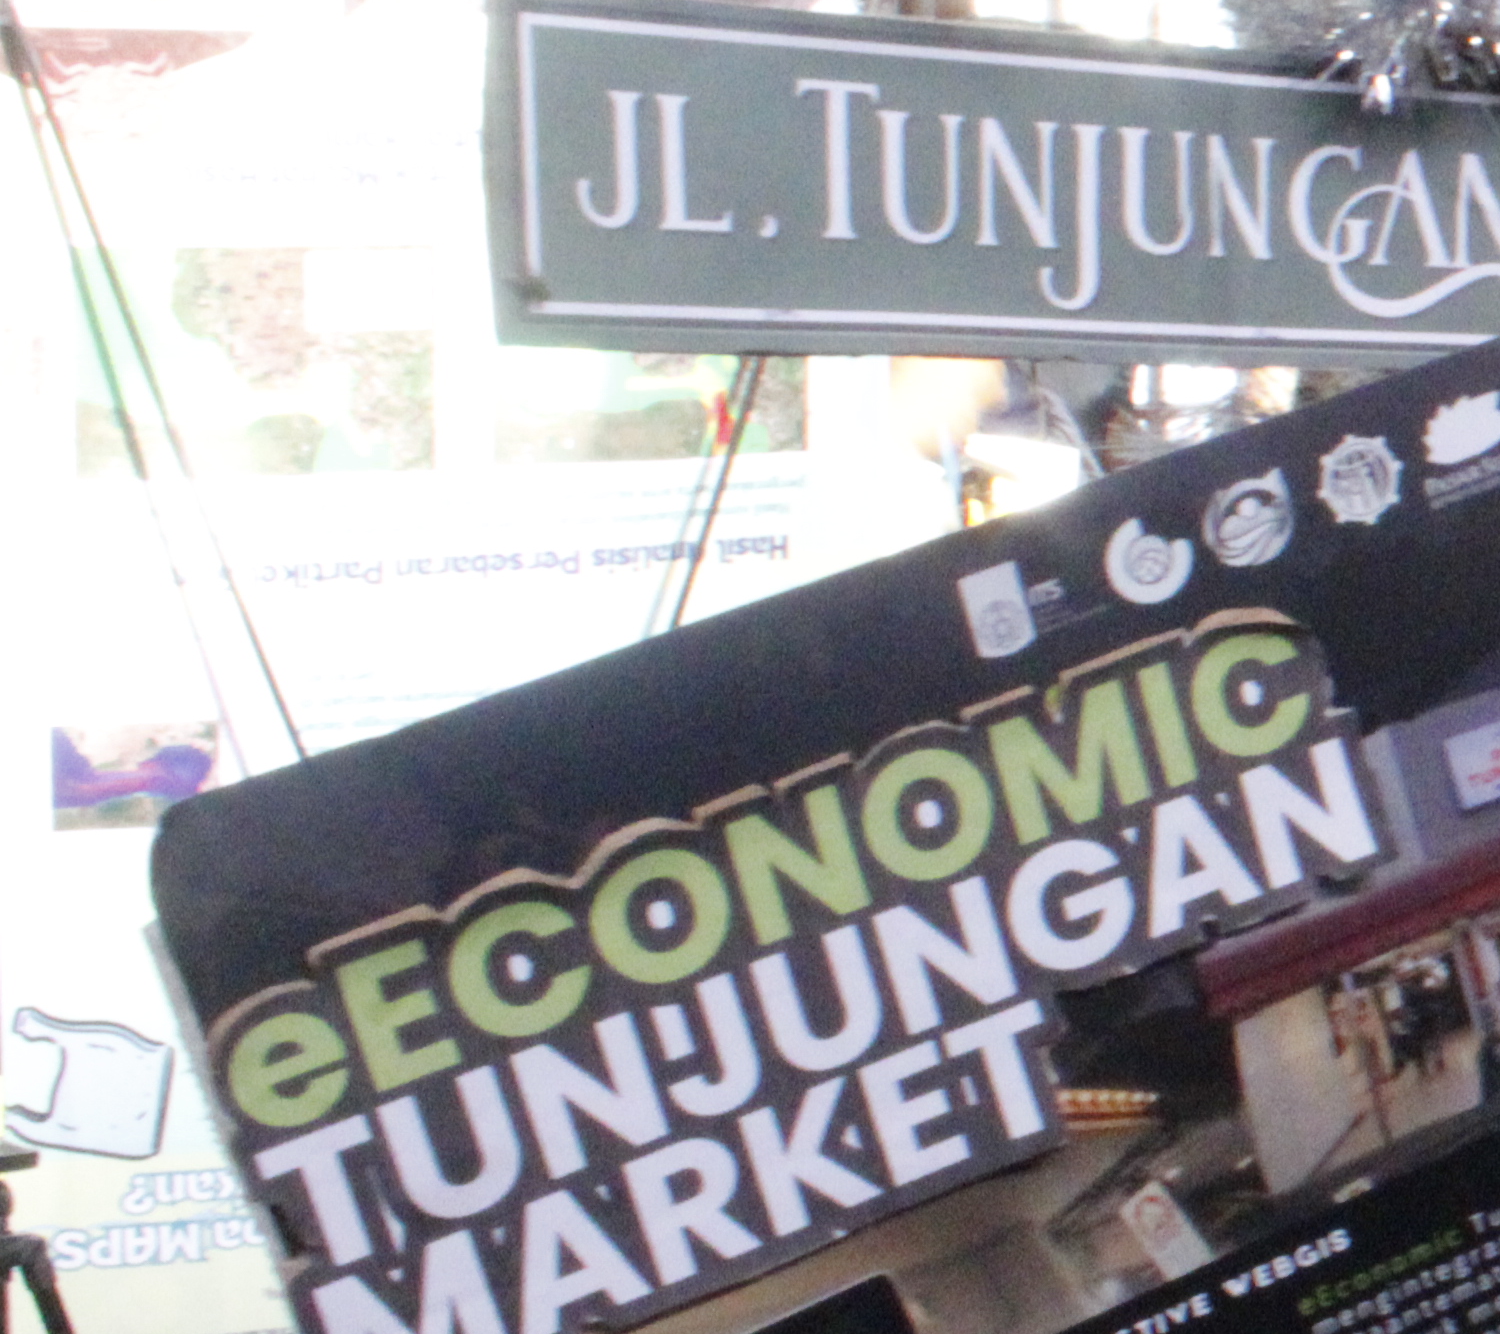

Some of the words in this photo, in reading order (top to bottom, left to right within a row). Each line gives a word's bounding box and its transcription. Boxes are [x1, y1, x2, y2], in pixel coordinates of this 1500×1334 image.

[226, 634, 1312, 1128] eECONOMIC
[255, 738, 1380, 1267] TUNJUNGAN
[50, 1220, 198, 1271] MAPS
[1223, 1227, 1352, 1298] WEBGIS
